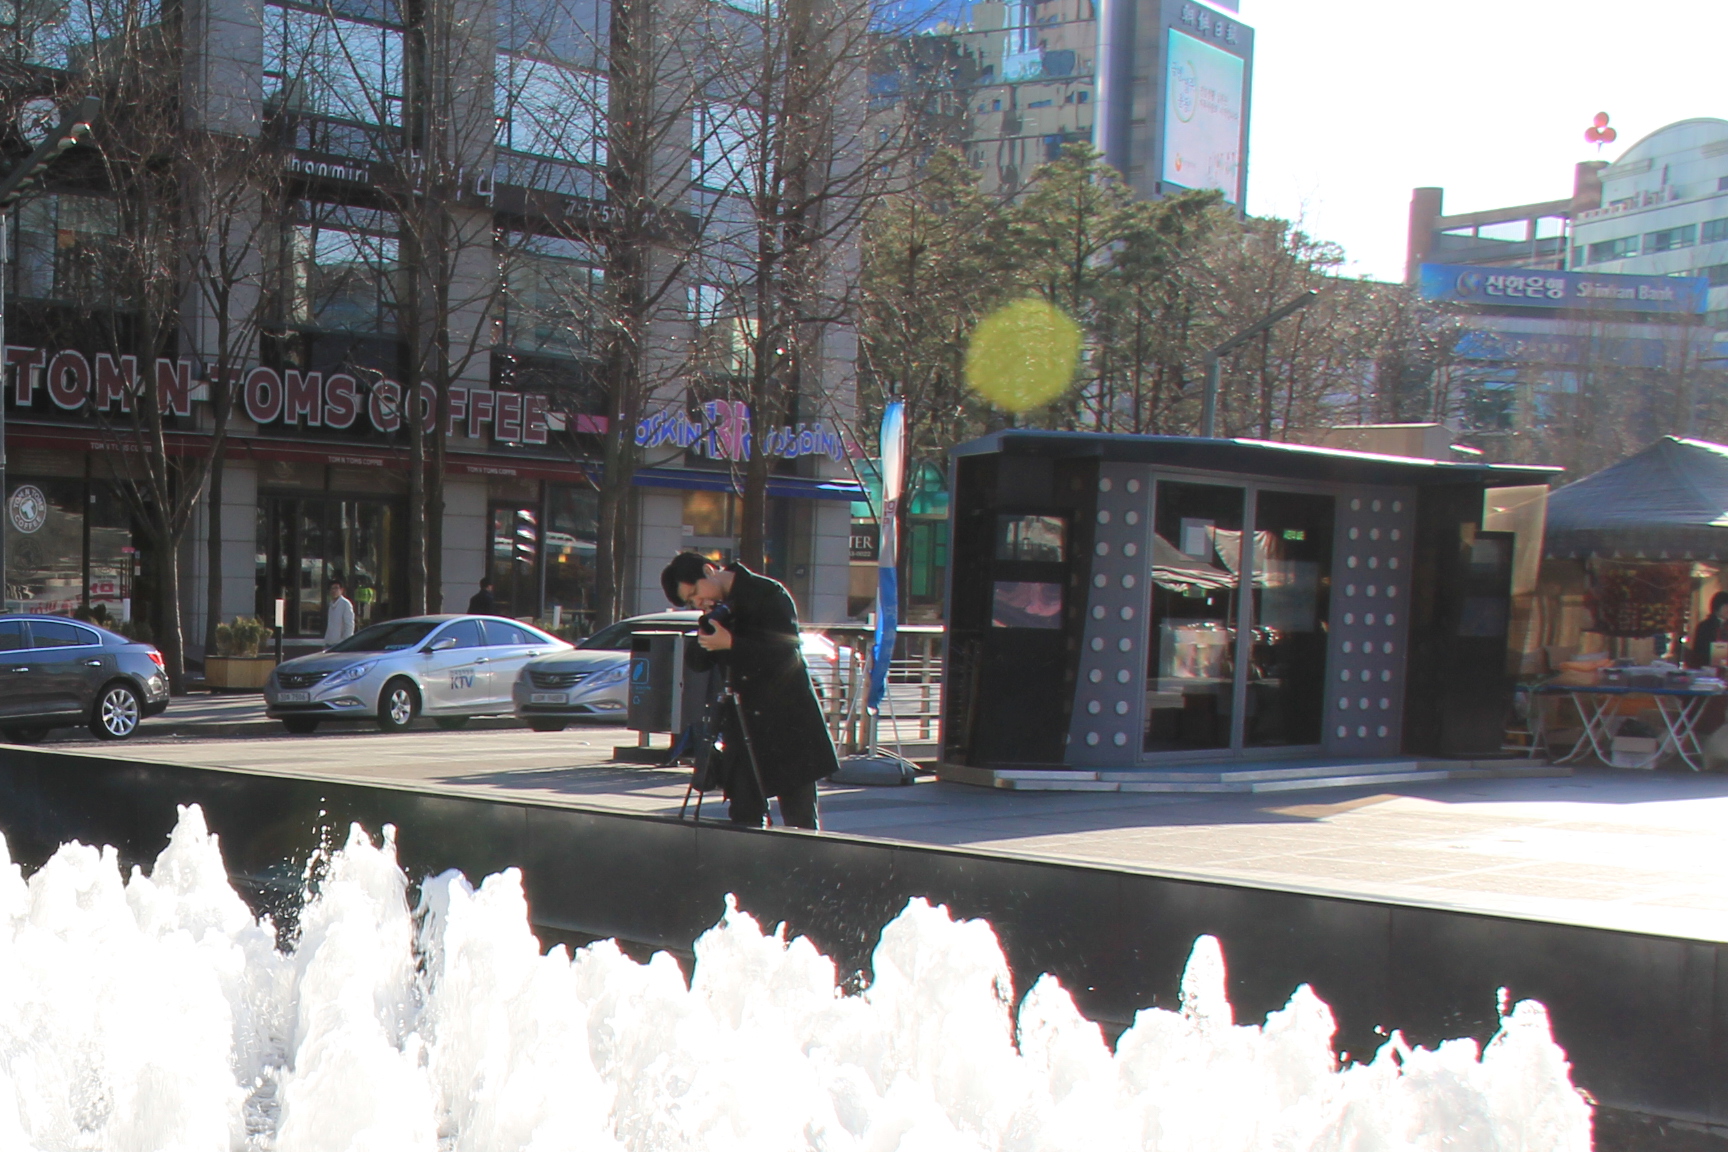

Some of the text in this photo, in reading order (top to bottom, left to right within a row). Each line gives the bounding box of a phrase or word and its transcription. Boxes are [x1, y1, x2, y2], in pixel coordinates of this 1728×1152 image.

[1485, 275, 1673, 300] 신한은행 Shinhan Bank
[4, 345, 547, 444] TOM N TOMS COFFEE
[14, 514, 42, 530] COFFEE
[451, 675, 474, 689] KTV
